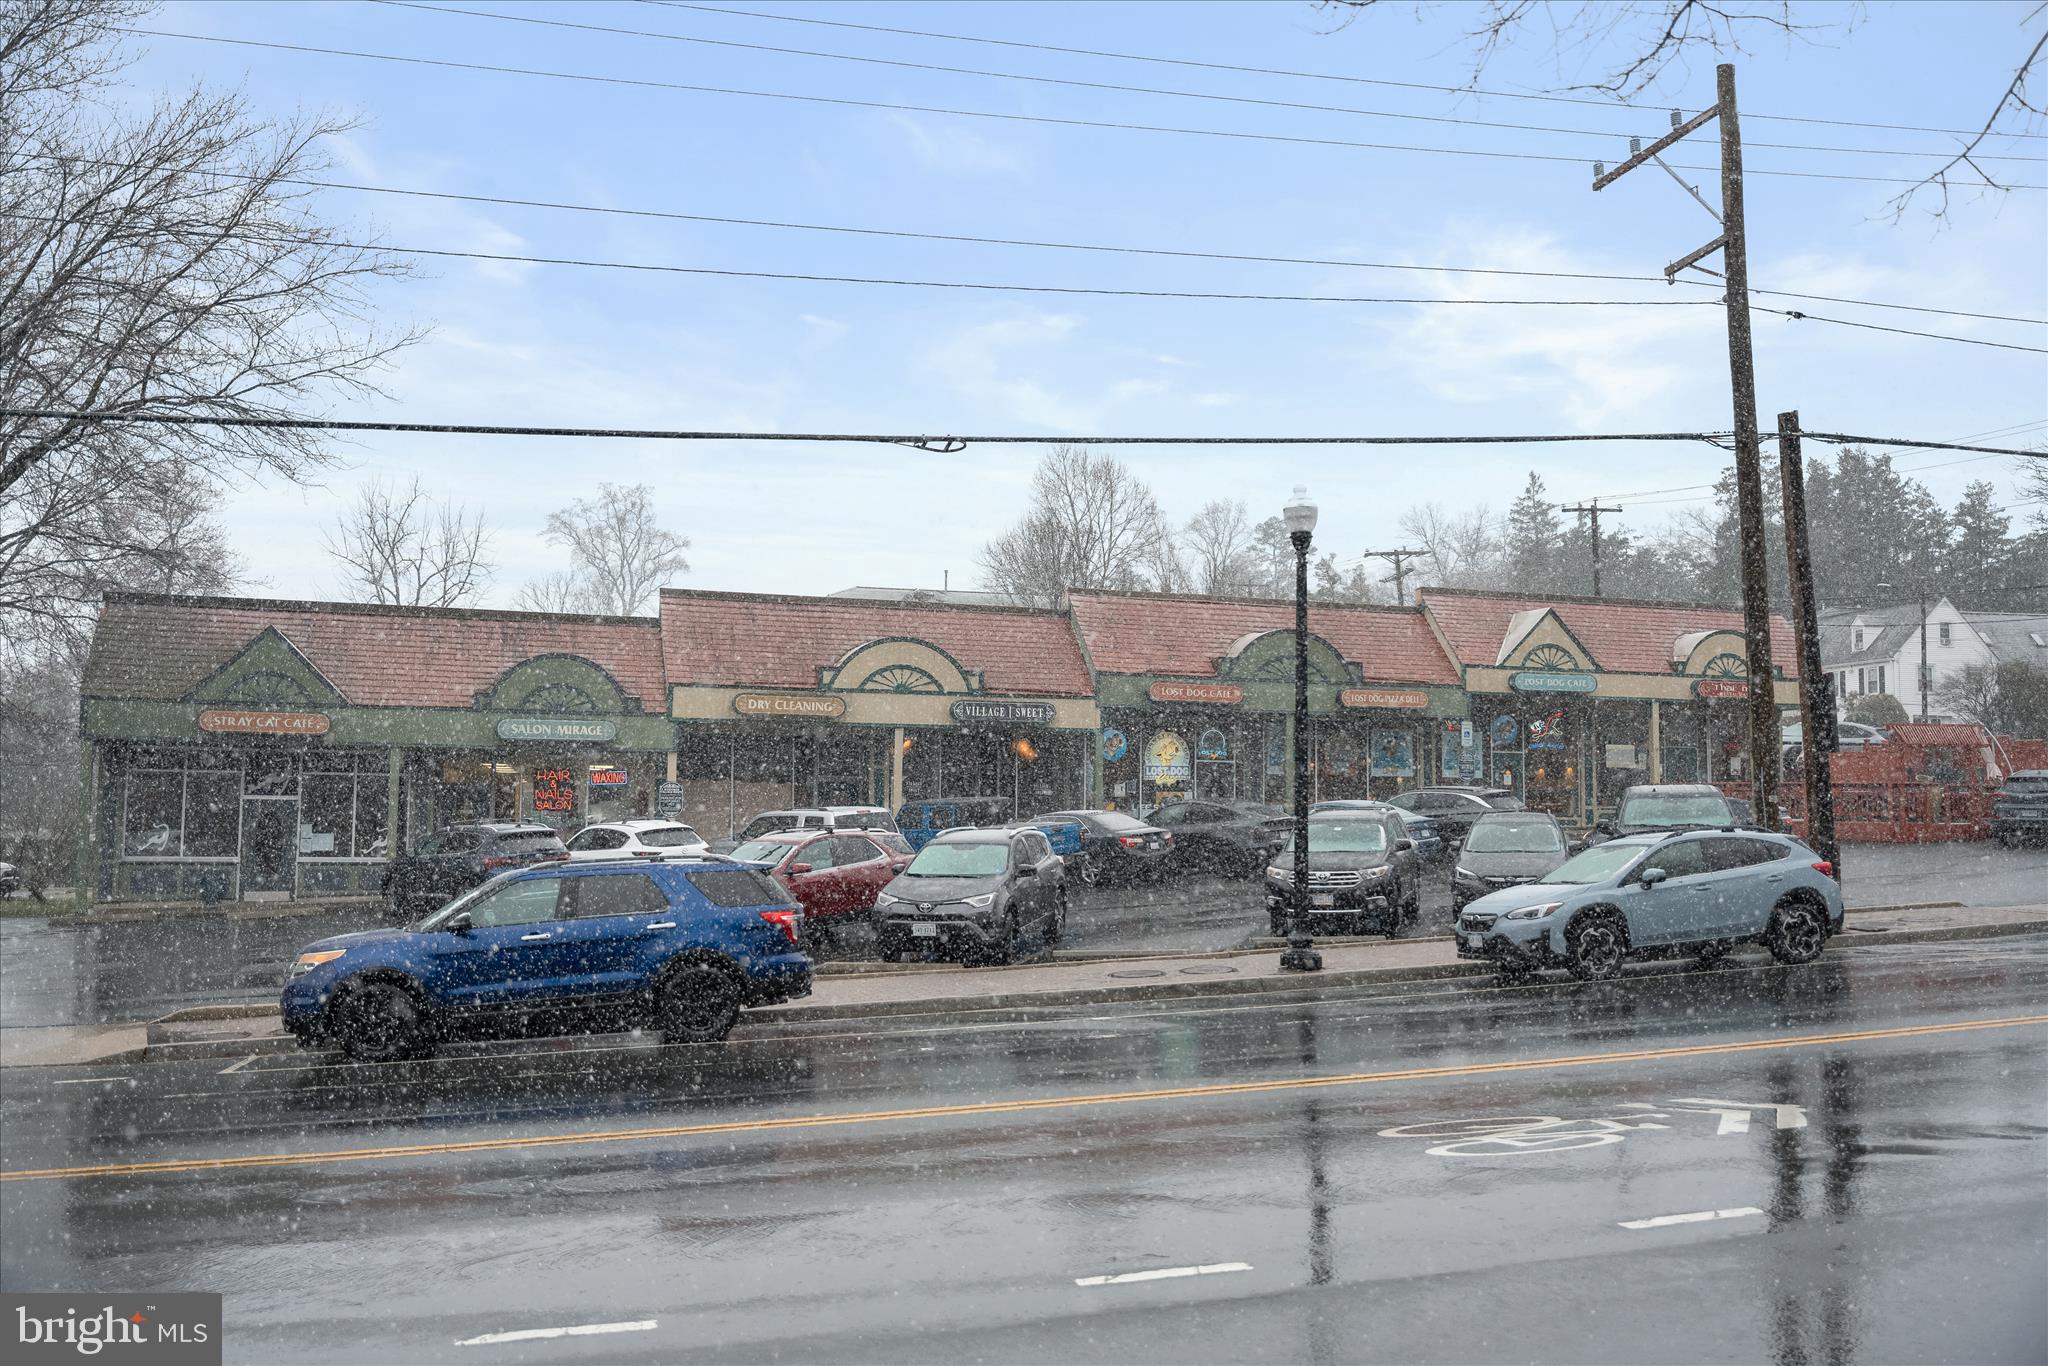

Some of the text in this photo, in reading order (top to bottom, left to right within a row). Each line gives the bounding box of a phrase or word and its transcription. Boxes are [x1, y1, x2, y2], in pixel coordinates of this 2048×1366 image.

[1547, 679, 1564, 687] DOG
[1161, 687, 1183, 696] LOST
[1186, 688, 1207, 697] DOG
[1351, 694, 1367, 702] LOST
[1368, 694, 1383, 703] DOG
[1405, 695, 1419, 704] DELI
[748, 699, 833, 712] DRY CLEANING
[965, 706, 1044, 718] VILLAGE SWEET
[213, 716, 252, 726] STRAY
[256, 716, 281, 727] CAT
[511, 723, 603, 736] SALON MIRAGE
[536, 769, 570, 780] HAIR
[1145, 766, 1189, 776] LOST DOG
[591, 772, 625, 783] WAXING
[534, 789, 573, 800] NAILS
[535, 800, 572, 810] SALON
